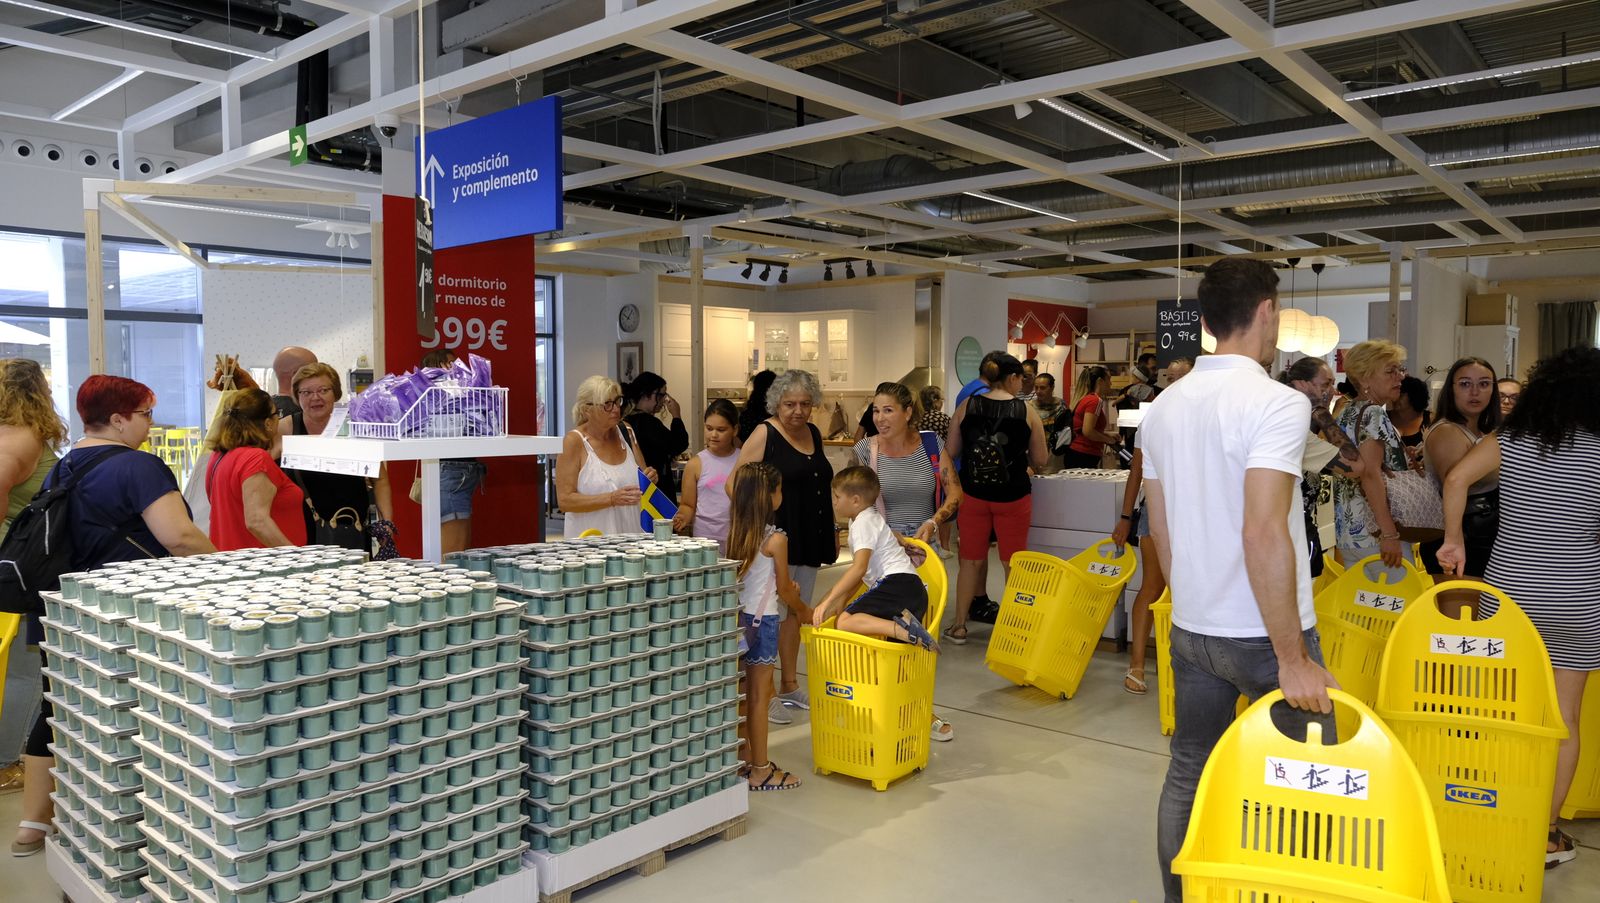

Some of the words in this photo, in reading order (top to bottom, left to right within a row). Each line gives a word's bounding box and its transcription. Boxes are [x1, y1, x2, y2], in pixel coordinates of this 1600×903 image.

[452, 152, 509, 181] Exposición
[452, 186, 459, 203] y
[461, 168, 538, 197] complemento
[438, 274, 507, 291] dormitorio
[445, 294, 488, 306] menos
[490, 295, 506, 307] de
[828, 685, 851, 697] IKEA
[1449, 788, 1494, 803] IKEA
